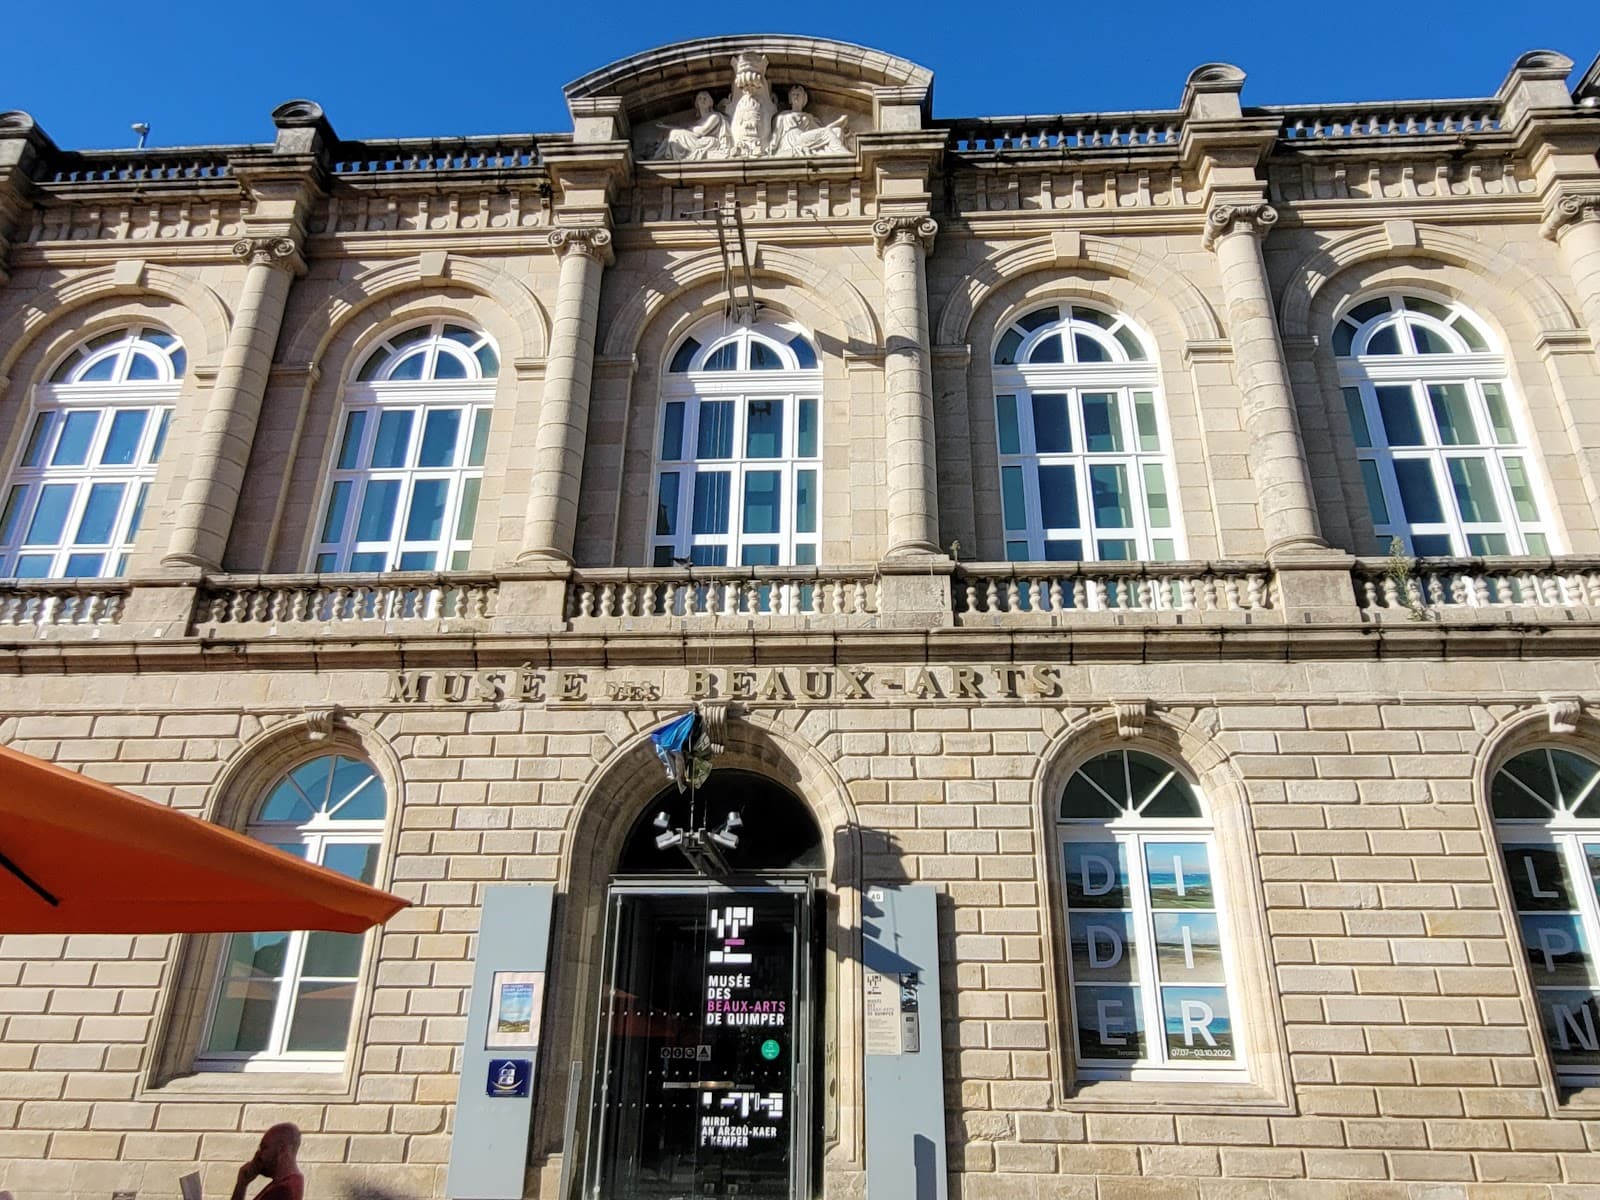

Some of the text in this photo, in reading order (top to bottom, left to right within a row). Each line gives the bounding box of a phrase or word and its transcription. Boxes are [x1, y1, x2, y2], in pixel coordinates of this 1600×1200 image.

[385, 662, 1059, 700] MUSÉE DES BEAUX-ARTS
[1081, 855, 1115, 896] D
[1523, 856, 1559, 898] L
[1087, 925, 1122, 968] D
[1538, 928, 1574, 972] P
[708, 974, 751, 988] MUSÉE
[708, 988, 731, 1000] DES
[706, 1012, 784, 1025] DE QUIMPER
[707, 1000, 786, 1012] BEAUX-ARTS
[1097, 1000, 1217, 1046] E R
[1552, 1004, 1600, 1050] N
[701, 1127, 715, 1136] AN
[702, 1116, 730, 1126] MIRDI
[701, 1136, 749, 1147] E KEMPER
